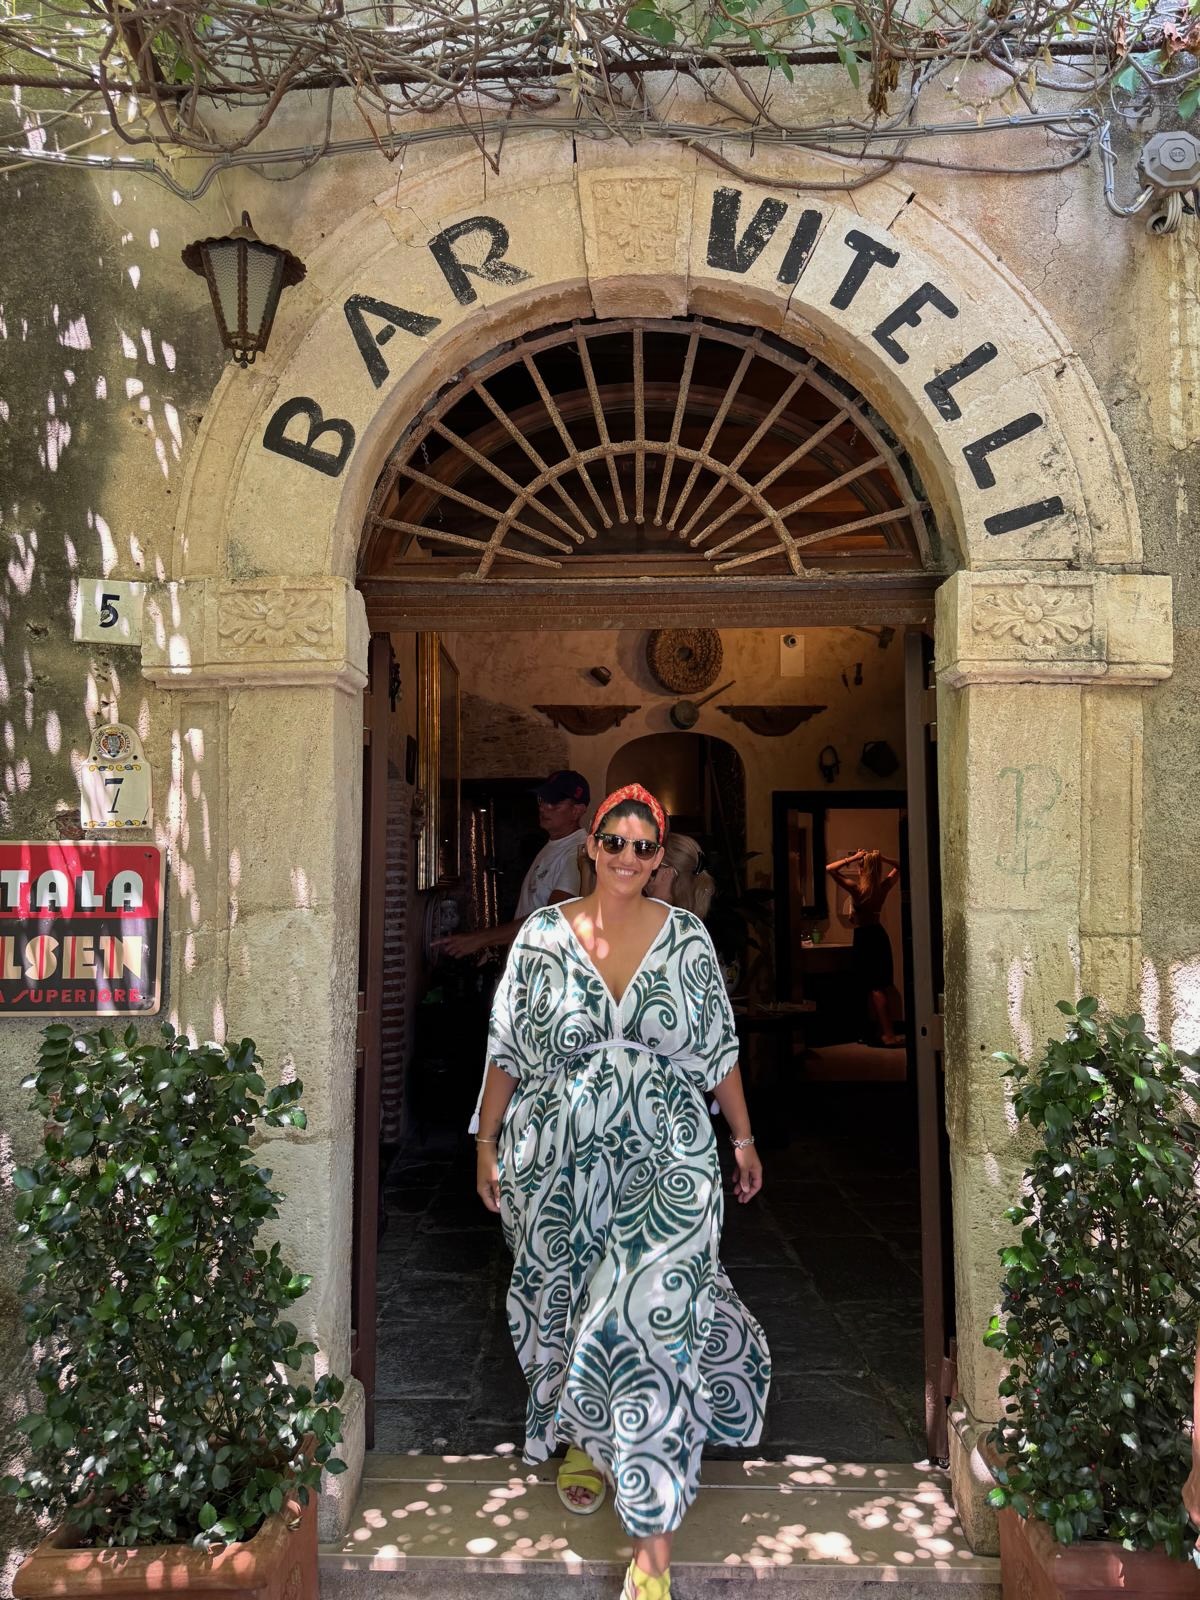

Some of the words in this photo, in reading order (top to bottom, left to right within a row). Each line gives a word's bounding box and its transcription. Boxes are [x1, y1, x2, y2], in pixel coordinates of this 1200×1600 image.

[263, 215, 533, 477] BAR
[706, 185, 1064, 536] VITELLI
[99, 593, 120, 628] 5
[104, 777, 124, 813] 7
[11, 988, 141, 1003] SUPERIORE
